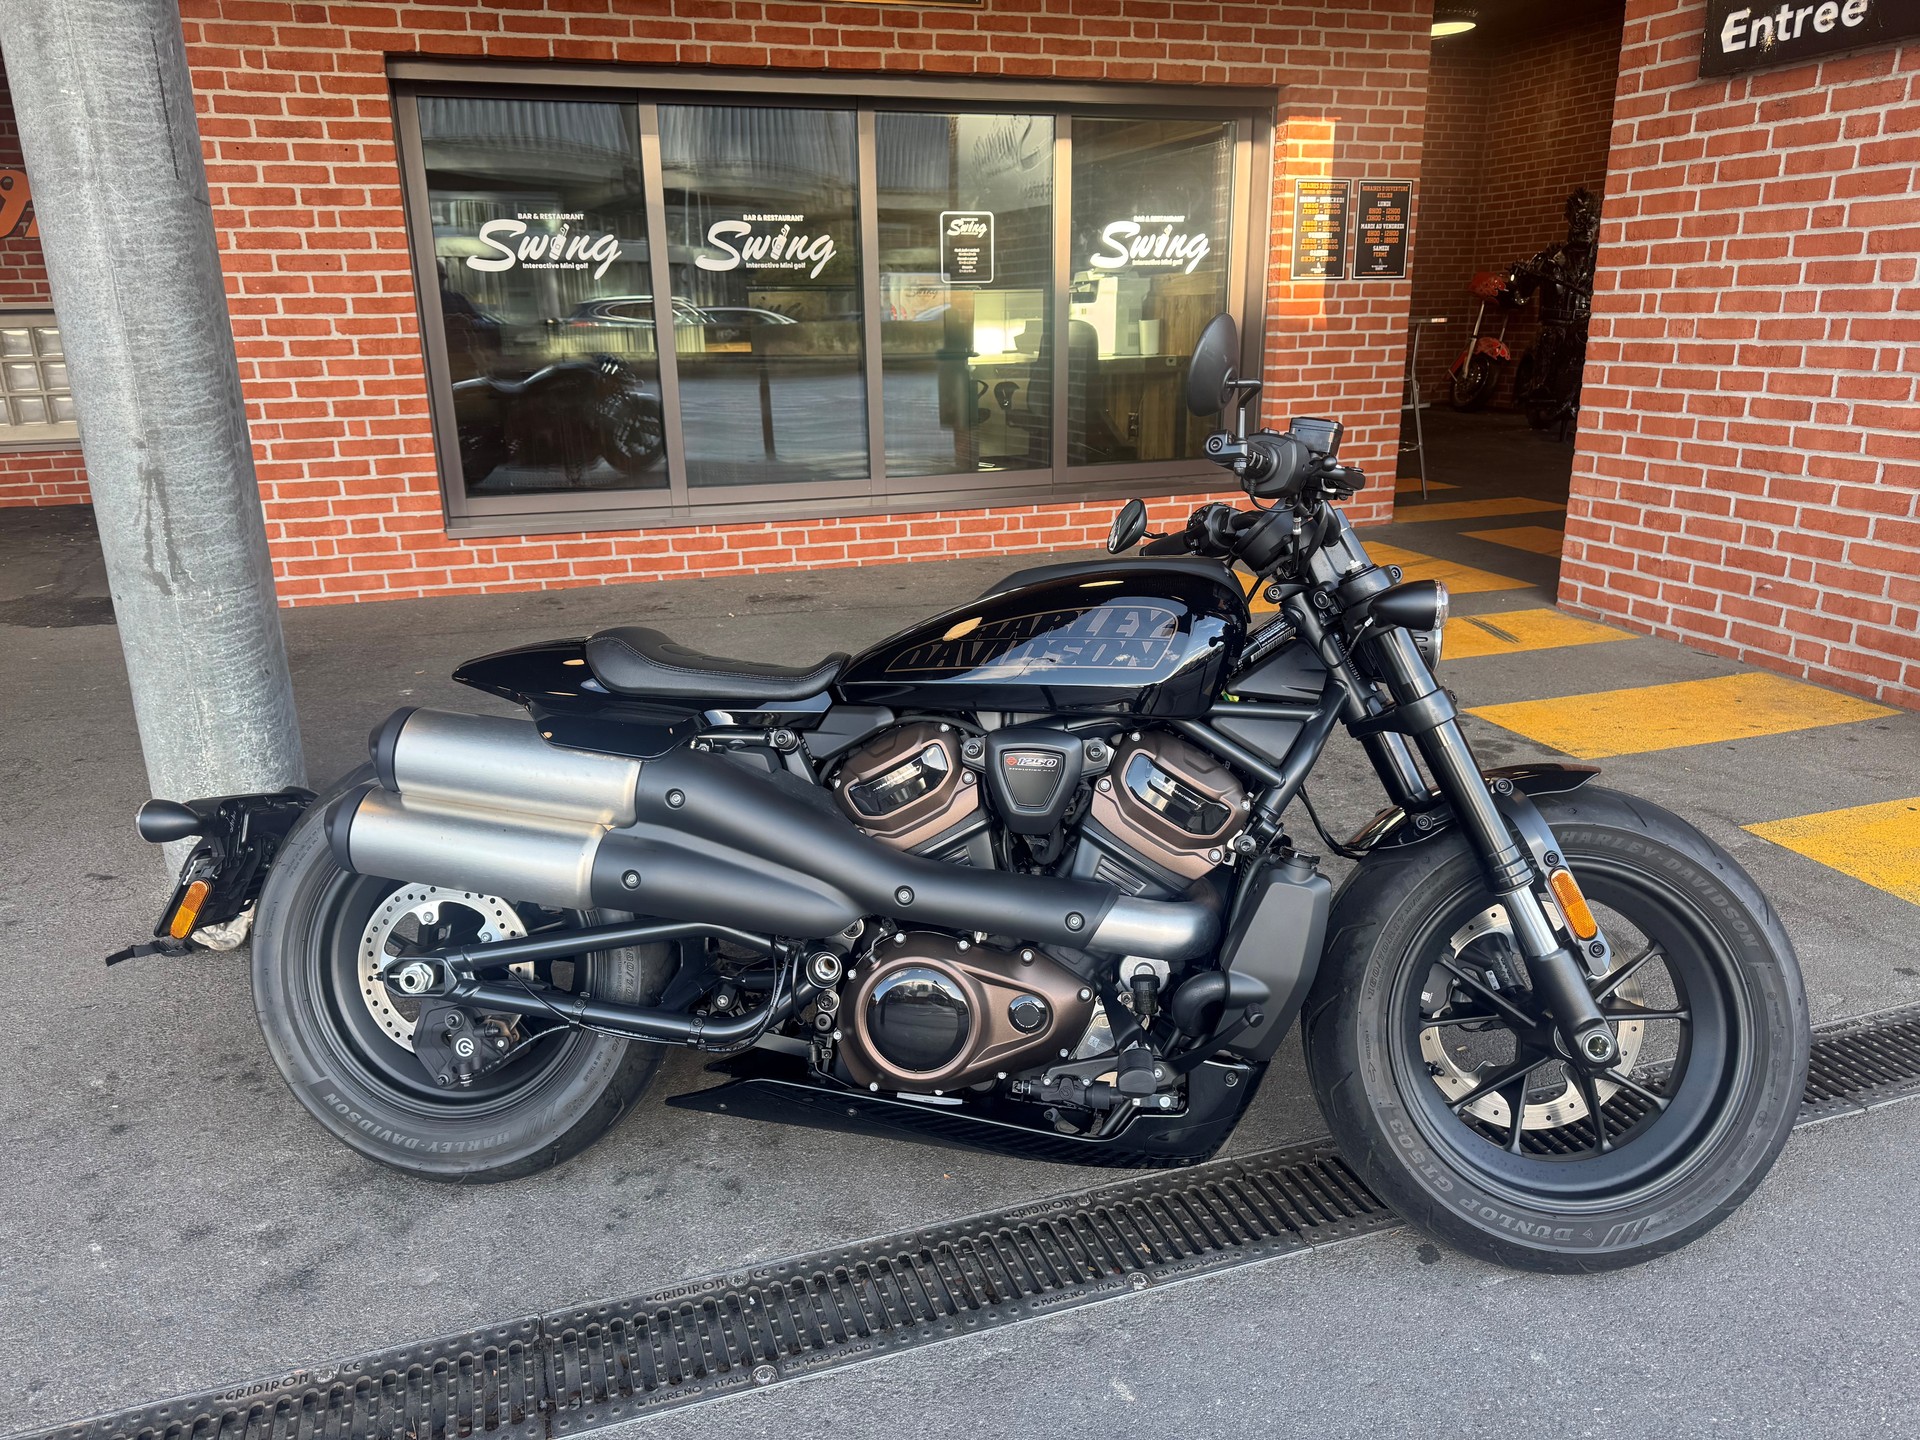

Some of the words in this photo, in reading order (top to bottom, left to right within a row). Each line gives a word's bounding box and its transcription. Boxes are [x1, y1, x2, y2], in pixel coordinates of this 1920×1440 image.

[539, 213, 584, 221] RESTAURANT
[743, 214, 757, 222] BAR
[763, 214, 804, 222] RESTAURANT
[947, 219, 987, 238] Swing
[466, 218, 622, 280] Swing
[695, 220, 837, 280] Swing
[1090, 220, 1210, 275] Swing
[522, 262, 559, 270] Interactive
[560, 262, 575, 270] Mini
[576, 262, 588, 271] golf
[746, 262, 779, 270] Interactive
[780, 262, 794, 270] Mini
[794, 262, 806, 270] golf
[965, 609, 1174, 641] HARLEY
[904, 640, 1154, 668] DAVIDSON
[1559, 831, 1762, 949] HARLEY-DAVIDSON
[323, 1092, 511, 1154] HARLEY-DAVIDSON
[1458, 1198, 1574, 1241] DUNLOP
[654, 1277, 725, 1302] GRIDIRON
[225, 1373, 309, 1401] GRIDIRON
[649, 1384, 702, 1405] MARENO
